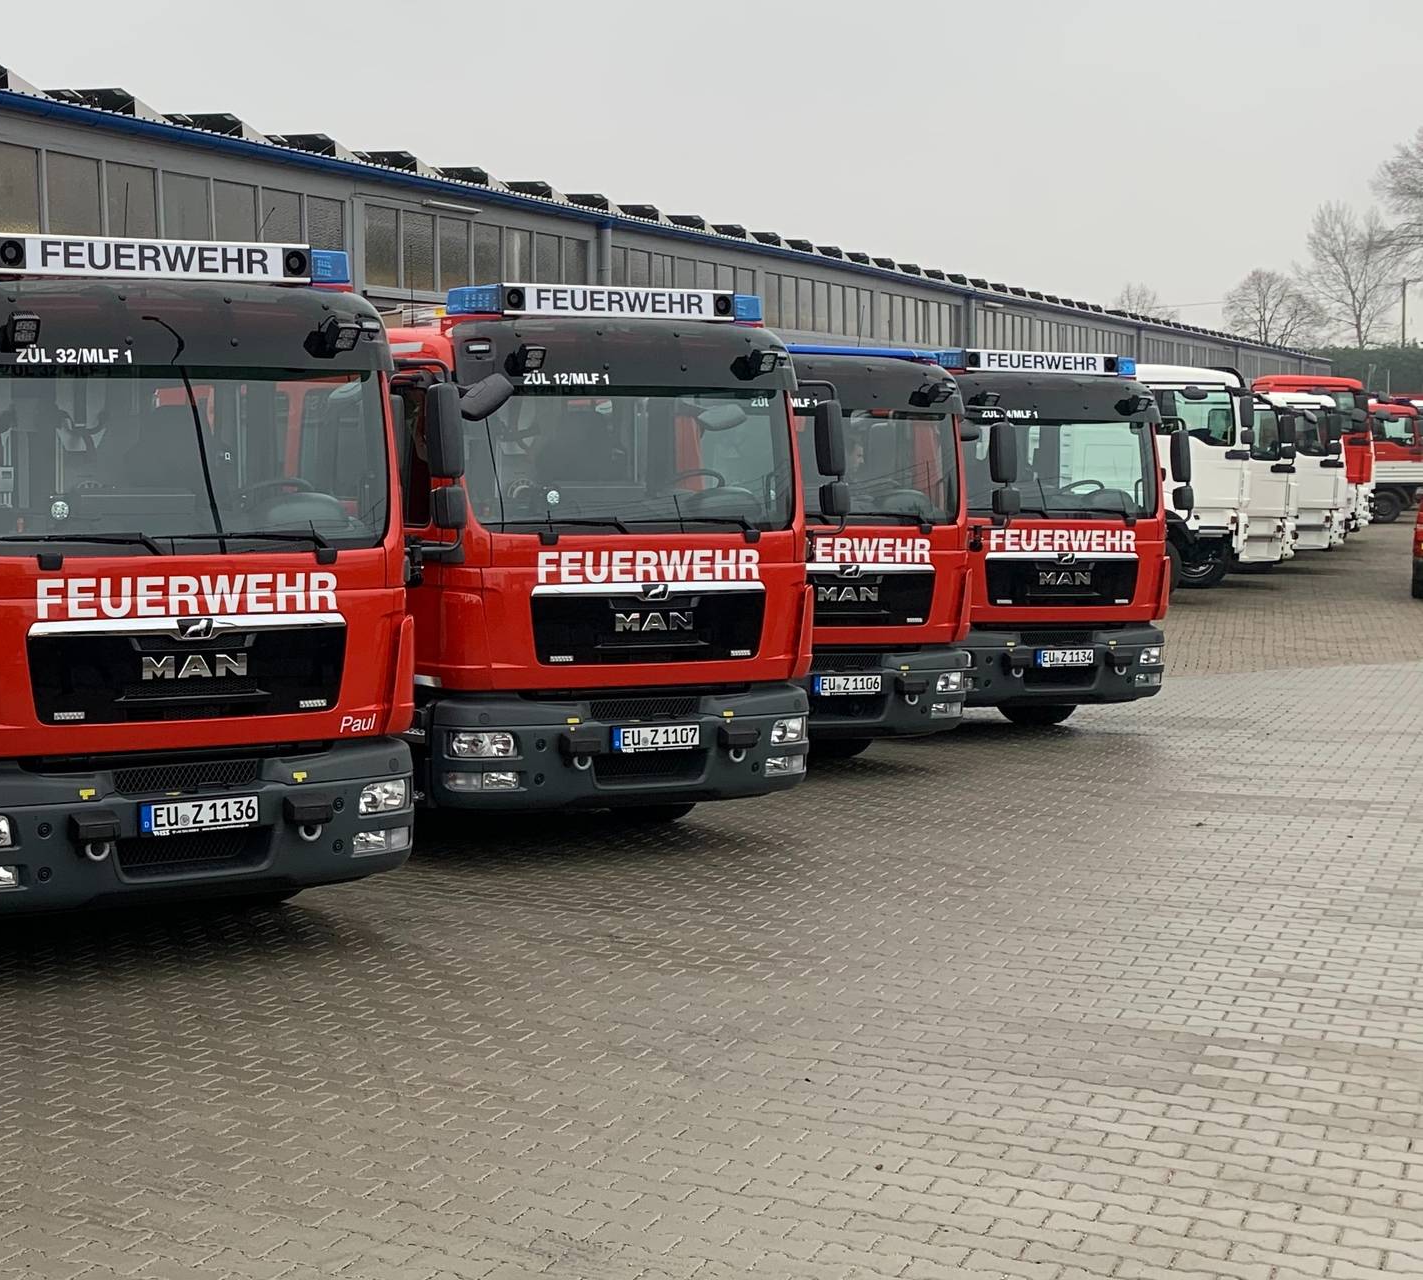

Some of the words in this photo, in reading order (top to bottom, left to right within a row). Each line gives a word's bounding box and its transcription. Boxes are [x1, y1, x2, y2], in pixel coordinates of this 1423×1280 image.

[40, 240, 268, 275] FEUERWEHR
[536, 288, 703, 315] FEUERWEHR
[15, 344, 52, 364] ZÜL
[56, 348, 118, 364] 32/MLF
[124, 349, 133, 364] 1
[987, 353, 1097, 371] FEUERWEHR
[523, 370, 551, 384] ZÜL
[553, 373, 599, 386] 12/MLF
[603, 374, 610, 385] 1
[1001, 410, 1032, 418] 4/MLF
[815, 537, 931, 563] ERWEHR
[990, 529, 1136, 552] FEUERWEHR
[537, 549, 760, 583] FEUERWEHR
[1038, 571, 1091, 585] MAN
[36, 572, 338, 619] FEUERWEHR
[817, 586, 879, 602] MAN
[614, 612, 694, 632] MAN
[142, 653, 248, 680] MAN
[1042, 652, 1055, 663] EU
[1061, 651, 1067, 662] Z
[1069, 651, 1092, 662] 1134
[821, 678, 836, 691] EU
[842, 678, 850, 691] Z
[852, 677, 880, 690] 1106
[339, 713, 376, 733] Paul
[622, 730, 641, 746] EU
[650, 729, 659, 745] Z
[663, 727, 697, 744] 1107
[153, 806, 179, 828] EU
[192, 804, 203, 825] Z
[208, 799, 256, 823] 1136
